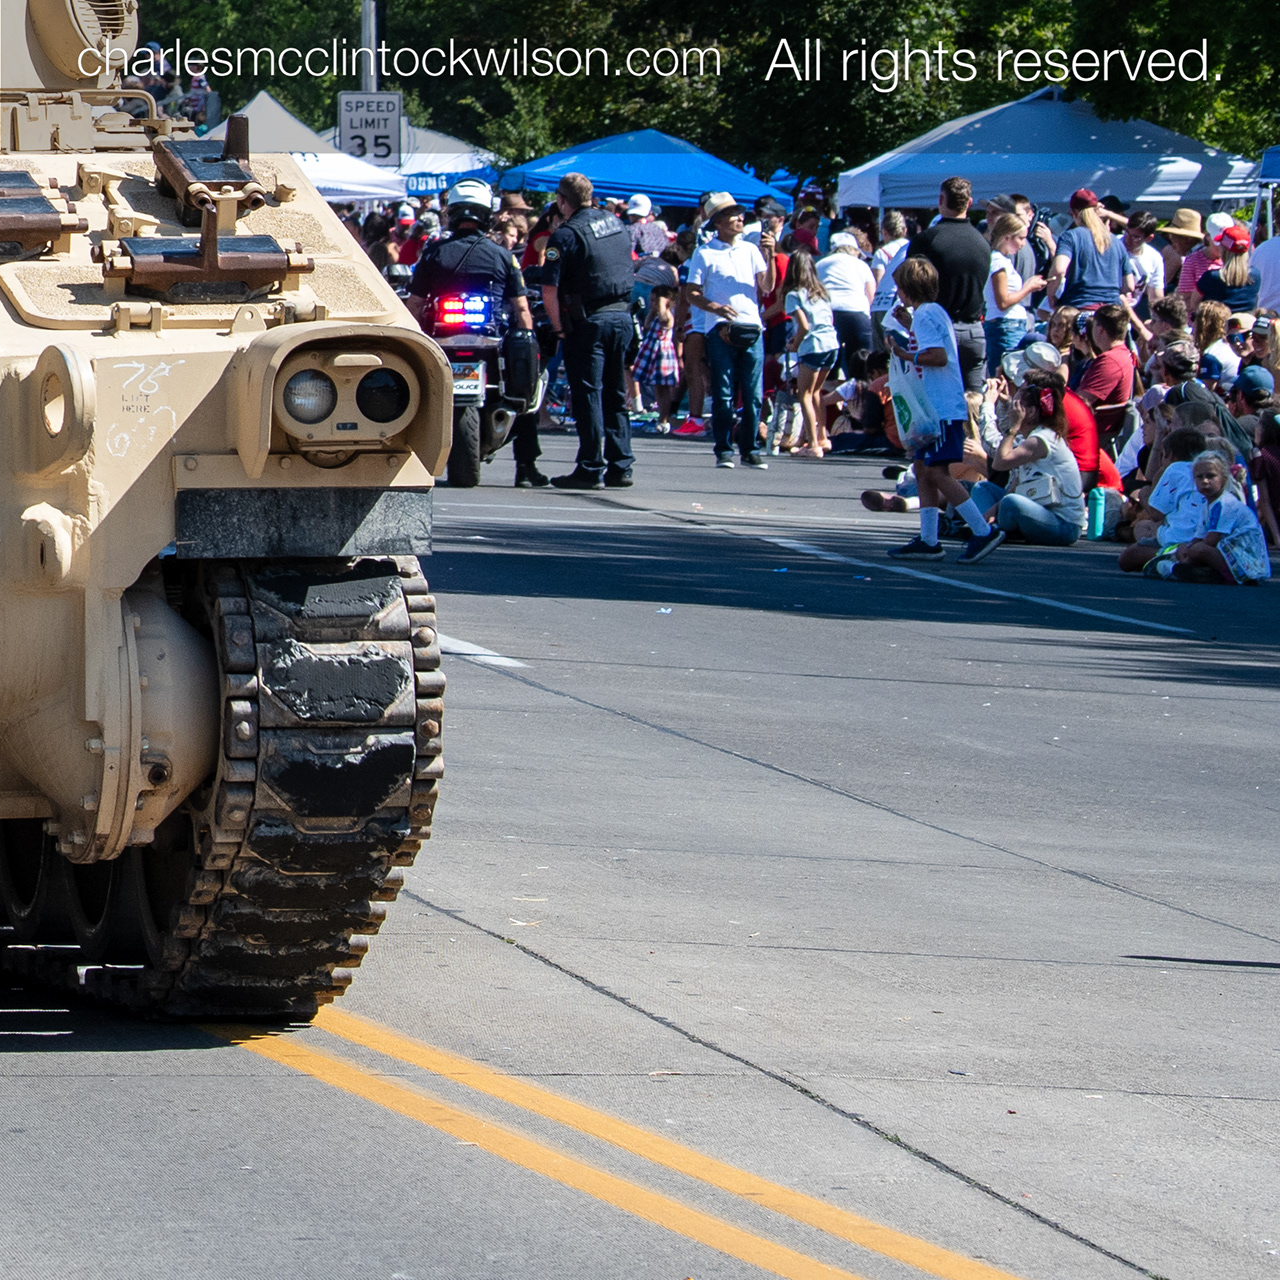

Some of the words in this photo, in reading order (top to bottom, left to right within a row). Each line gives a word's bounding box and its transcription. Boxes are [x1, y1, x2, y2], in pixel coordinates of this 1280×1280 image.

[344, 100, 396, 113] SPEED
[349, 118, 390, 130] LIMIT
[349, 134, 392, 158] 35
[407, 174, 447, 191] OUNG
[121, 391, 150, 402] LIFT
[121, 404, 150, 413] HERE
